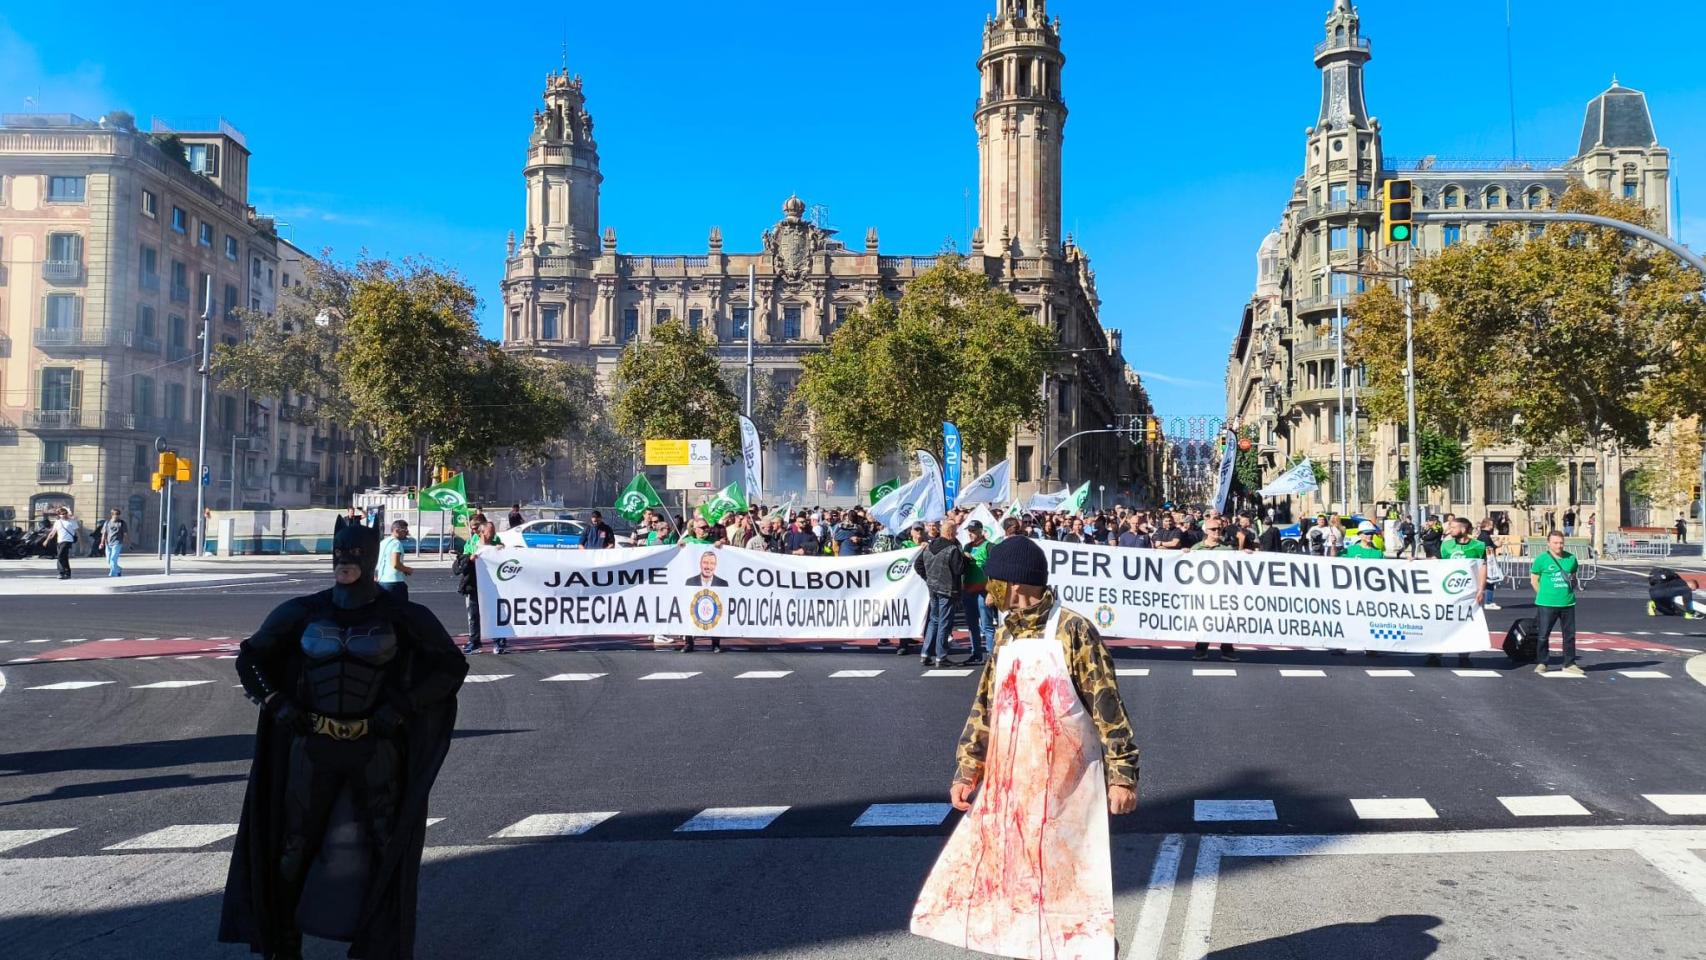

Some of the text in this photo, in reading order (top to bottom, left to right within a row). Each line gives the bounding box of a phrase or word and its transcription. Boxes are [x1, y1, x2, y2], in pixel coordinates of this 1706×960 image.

[502, 565, 523, 575] CSIF
[544, 567, 870, 590] JAUME COLLBONI
[891, 564, 911, 575] CSIF
[1050, 549, 1433, 594] PER UN CONVENI DIGNE
[1447, 577, 1472, 588] CSIF
[496, 592, 911, 627] DESPRECIA A LA POLICÍA GUARDIA URBANA
[1063, 585, 1094, 603] QUE
[1099, 587, 1117, 604] ES
[1122, 589, 1205, 611] RESPECTIN
[1210, 594, 1239, 611] LES
[1244, 596, 1341, 615] CONDICIONS
[1347, 599, 1431, 620] LABORALS
[1435, 604, 1454, 621] DE
[1458, 604, 1474, 621] LA
[1139, 612, 1345, 638] POLICIA GUÀRDIA URBANA
[1370, 621, 1397, 629] Guardia
